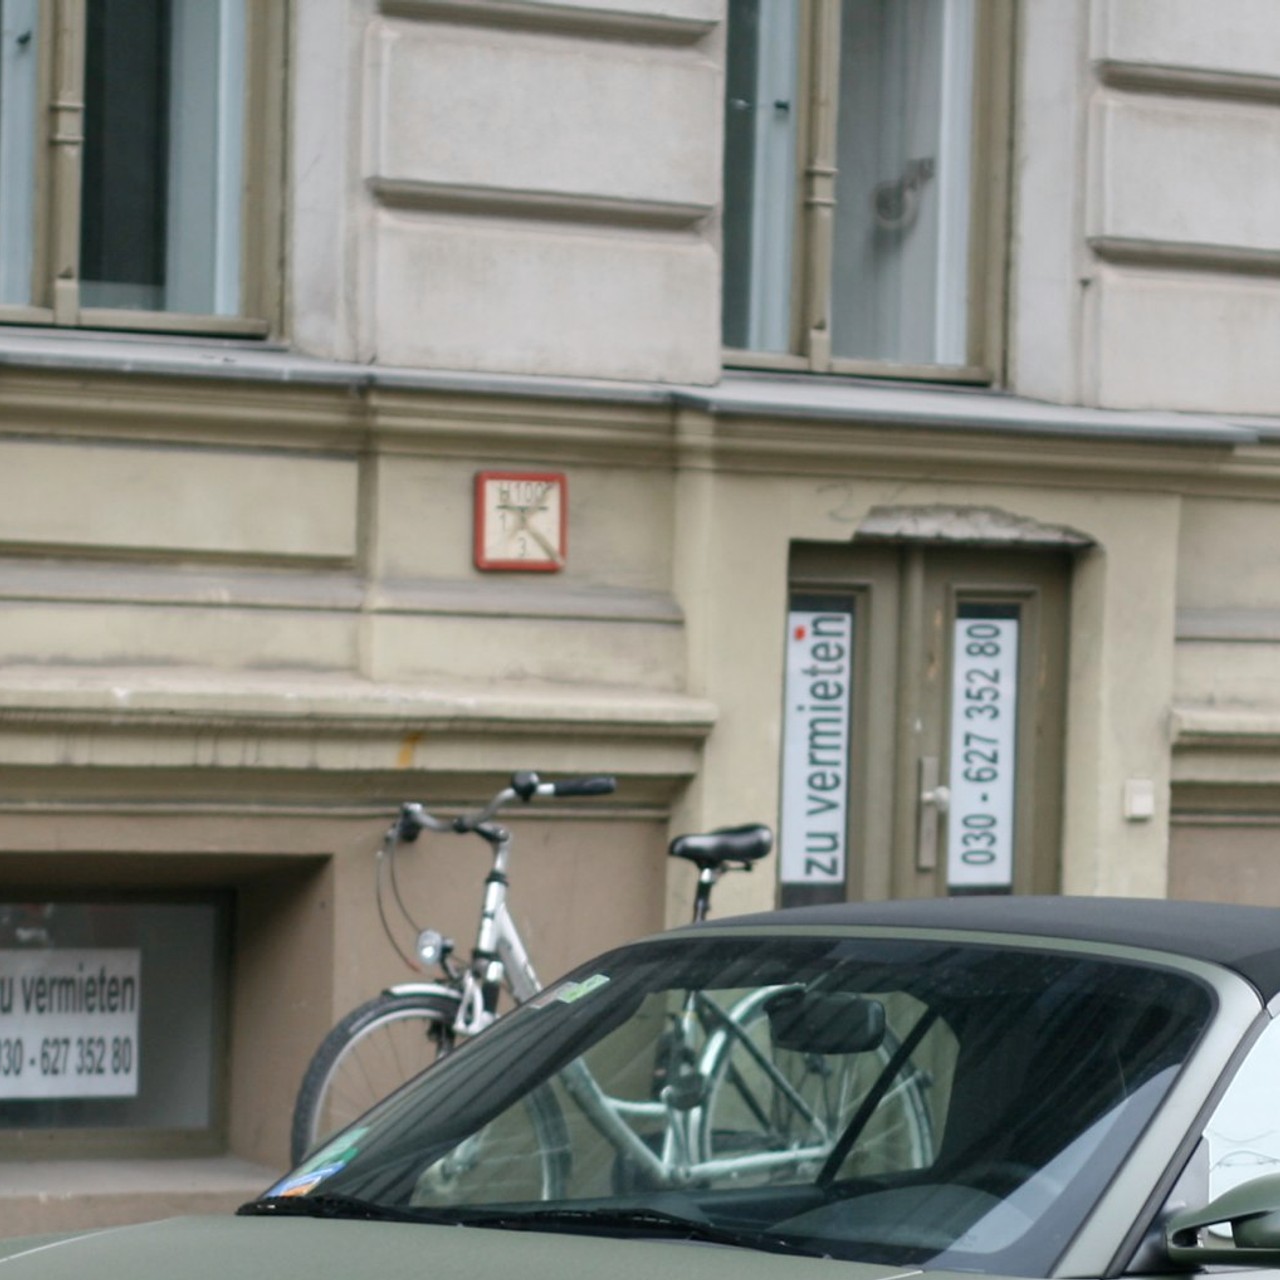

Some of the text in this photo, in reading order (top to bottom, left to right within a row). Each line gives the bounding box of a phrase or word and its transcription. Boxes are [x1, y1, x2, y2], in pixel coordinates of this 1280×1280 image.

[965, 623, 1001, 657] 80
[965, 669, 1000, 720] 352
[796, 615, 845, 876] zu vermieten
[963, 733, 999, 783] 627
[961, 813, 997, 865] 030
[21, 962, 136, 1014] vermieten
[41, 1037, 70, 1076] 627
[76, 1036, 106, 1075] 352
[112, 1036, 132, 1075] 80
